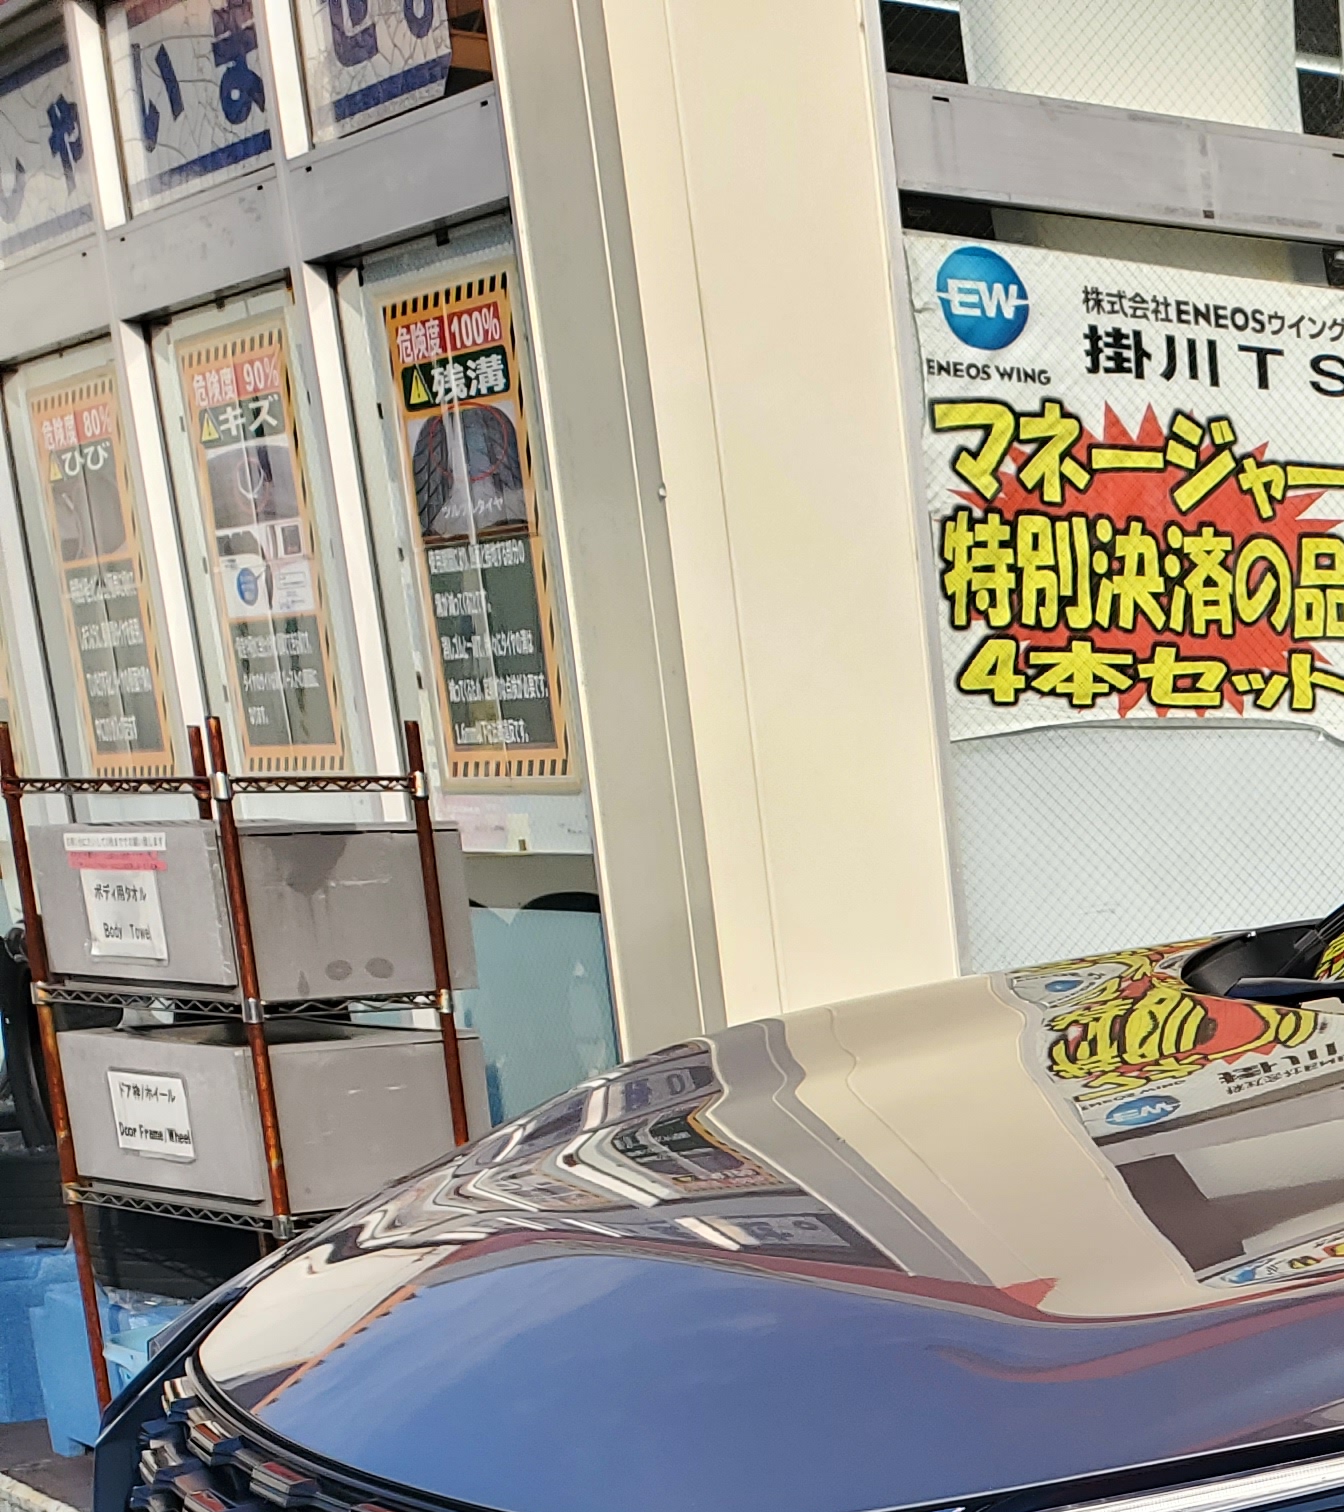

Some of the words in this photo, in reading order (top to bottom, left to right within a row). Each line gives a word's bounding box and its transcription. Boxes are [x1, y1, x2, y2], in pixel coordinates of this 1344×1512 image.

[949, 279, 1018, 320] EW
[397, 318, 444, 364] 危険度
[451, 305, 501, 350] 100%
[242, 355, 279, 392] 90%
[926, 357, 992, 381] ENEOS
[994, 366, 1052, 386] WING
[83, 403, 112, 437] 80%
[217, 393, 279, 437] キズ
[61, 441, 110, 476] ひび
[94, 883, 147, 901] ボディ用タオル
[103, 922, 123, 940] Body
[129, 923, 152, 941] Towel
[119, 1121, 137, 1137] Door
